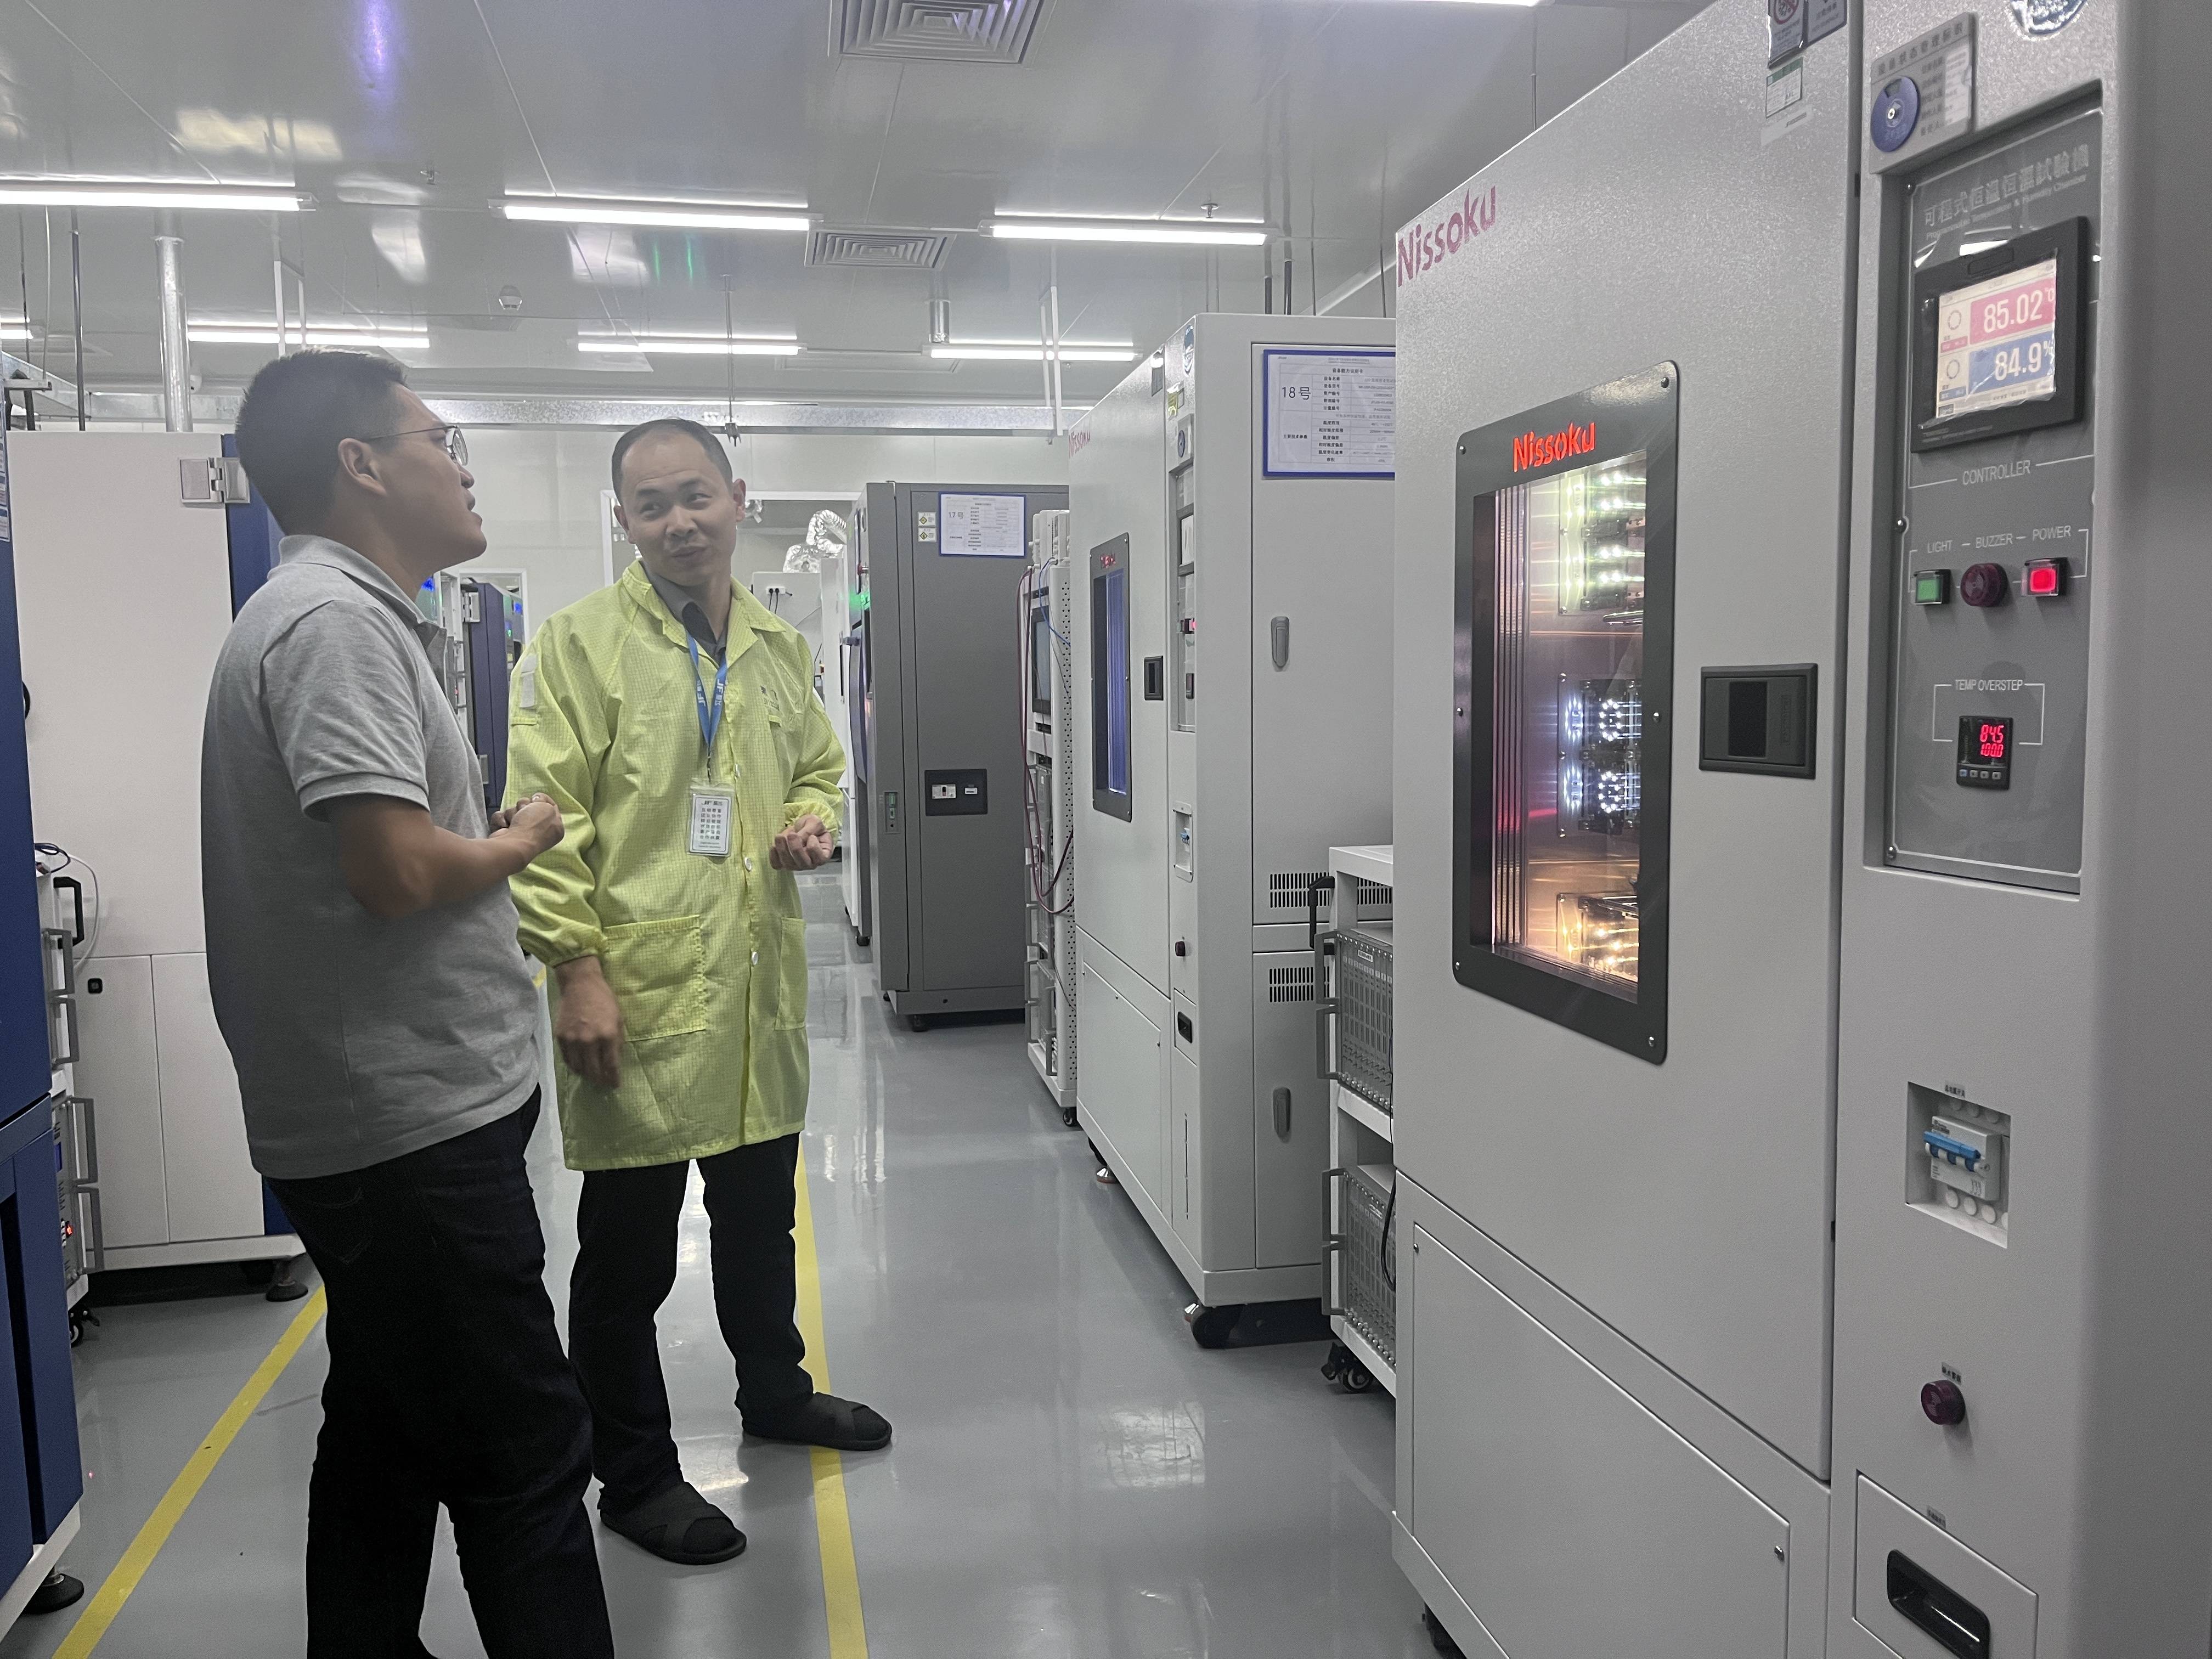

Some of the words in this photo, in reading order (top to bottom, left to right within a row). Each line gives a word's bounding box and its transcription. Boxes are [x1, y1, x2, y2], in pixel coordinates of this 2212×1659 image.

[1983, 290, 2043, 333] 85.02
[1994, 342, 2042, 381] 84.9
[1282, 386, 1311, 400] 18号
[1513, 423, 1595, 472] Nissoku
[1962, 460, 2031, 485] CONTROLLER
[1927, 540, 1953, 553] LIGHT
[1976, 533, 2013, 548] BUZZER
[2032, 525, 2072, 540] POWER
[1955, 679, 1977, 690] TEMP
[1978, 679, 2023, 691] OVERSTEP
